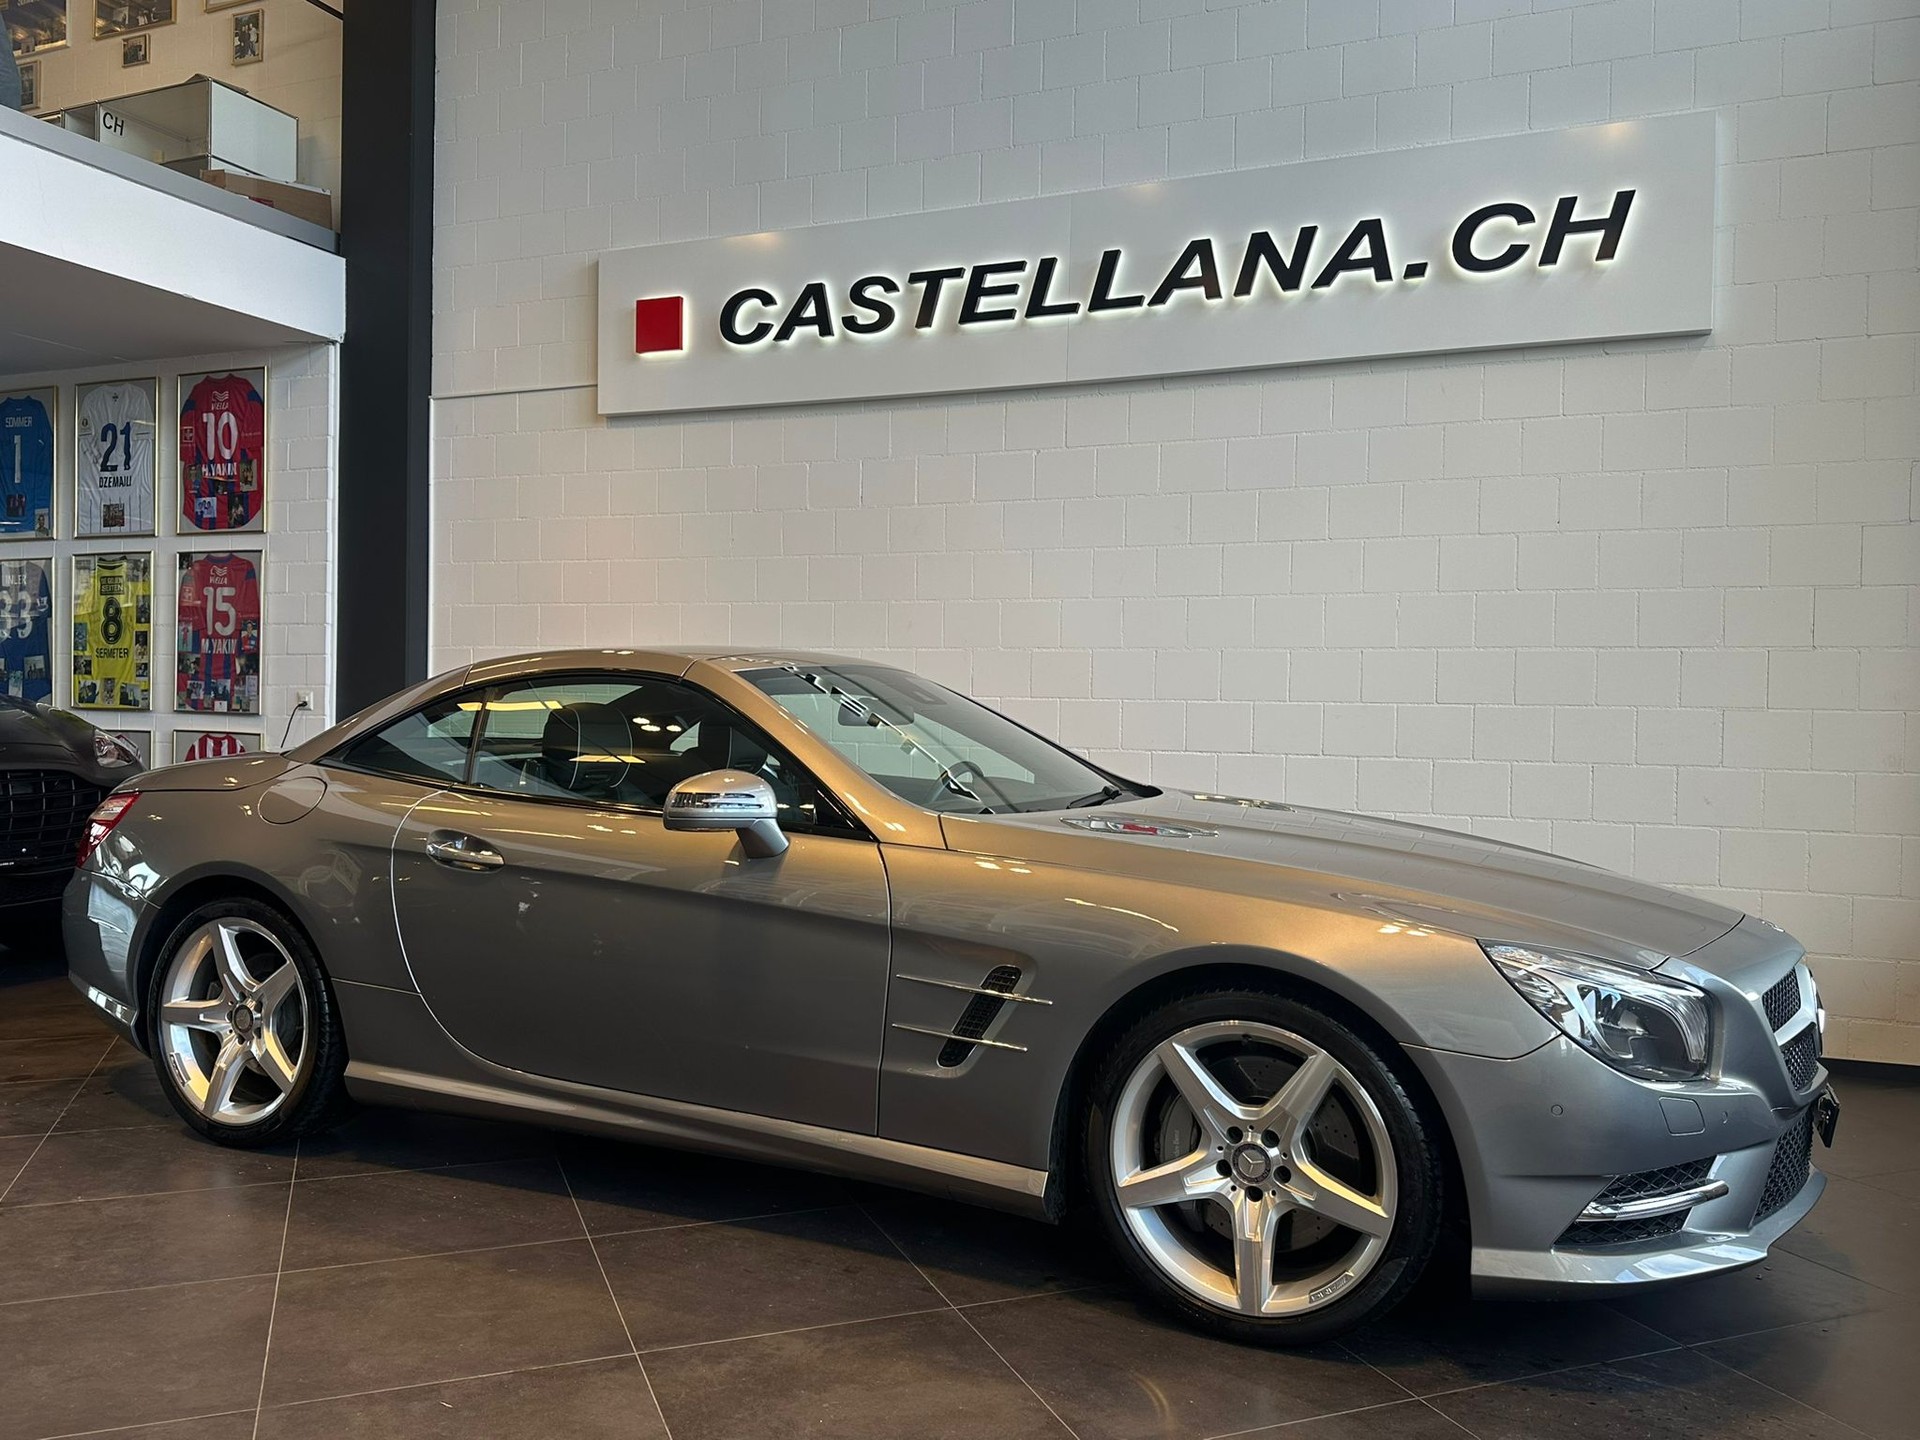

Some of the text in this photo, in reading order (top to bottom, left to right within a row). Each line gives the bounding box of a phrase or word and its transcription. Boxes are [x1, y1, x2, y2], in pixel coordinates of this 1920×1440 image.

[103, 111, 124, 136] CH
[718, 189, 1637, 346] CASTELLANA.CH
[5, 416, 33, 428] SOMMER
[100, 421, 131, 472] 21
[202, 411, 239, 461] 10
[14, 434, 21, 484] 1
[98, 476, 132, 489] DZEMAILI
[101, 596, 124, 646] 8
[203, 586, 237, 637] 15
[95, 647, 129, 659] SERMETER
